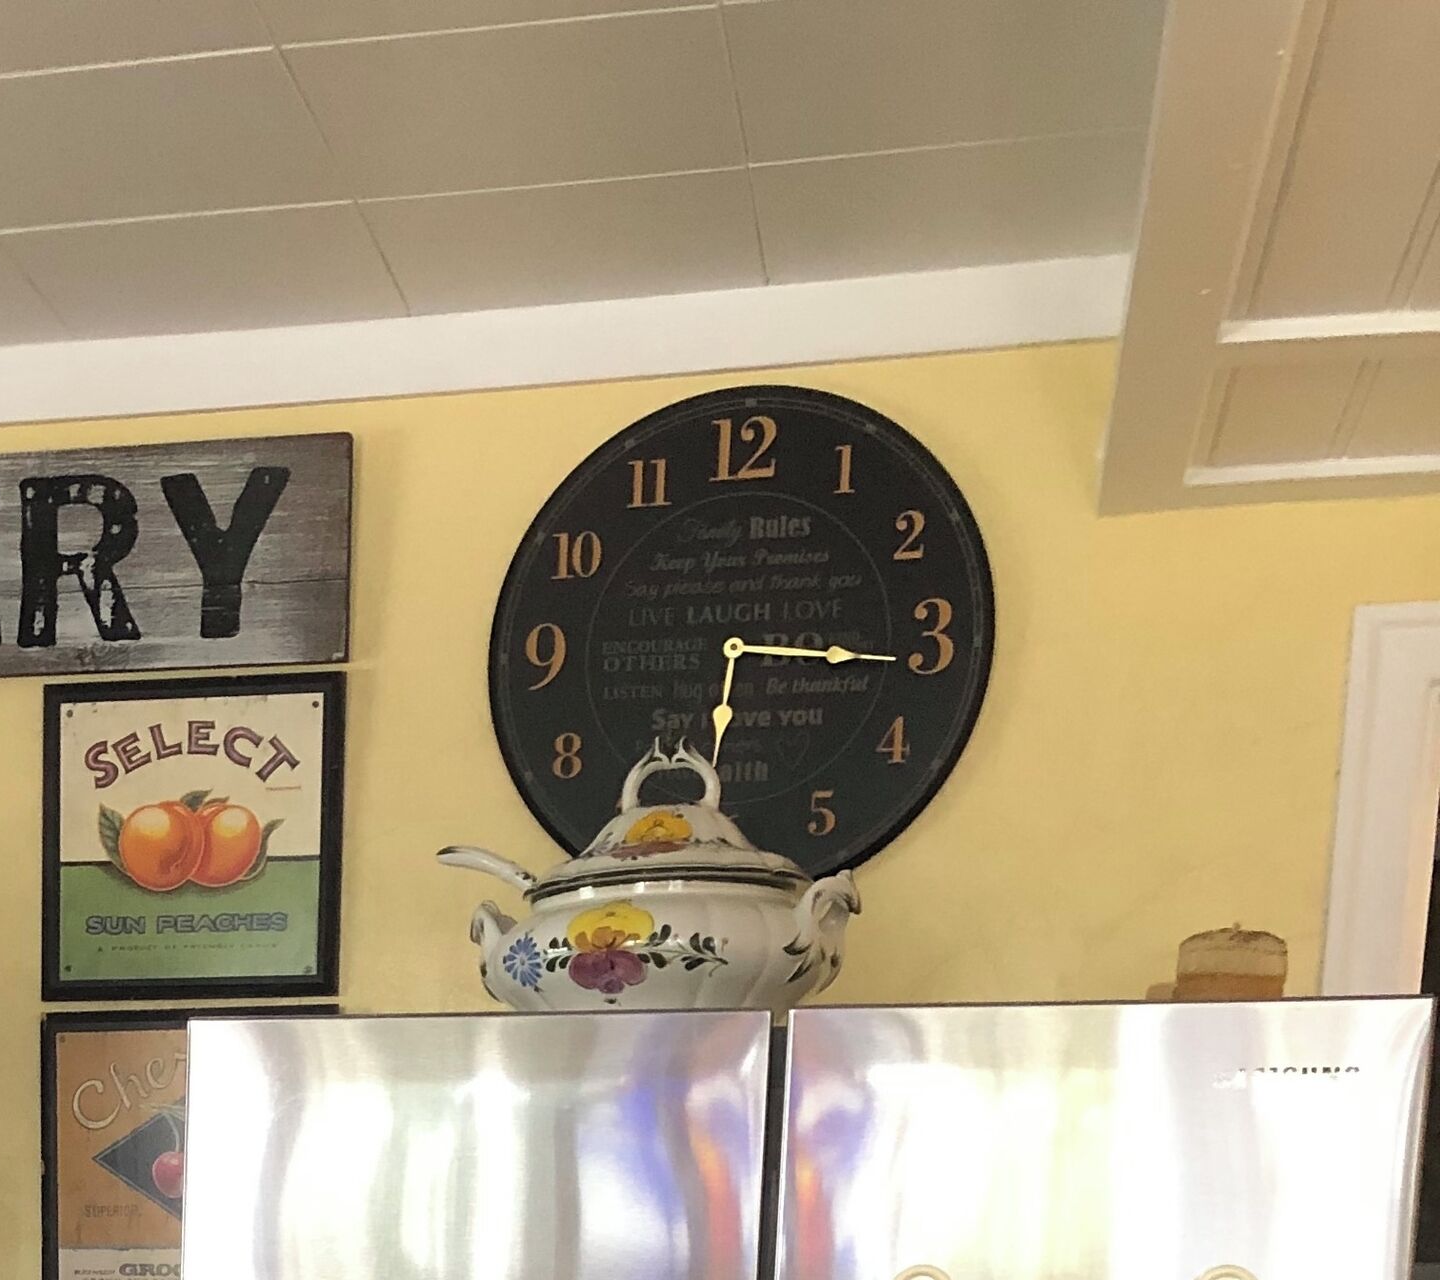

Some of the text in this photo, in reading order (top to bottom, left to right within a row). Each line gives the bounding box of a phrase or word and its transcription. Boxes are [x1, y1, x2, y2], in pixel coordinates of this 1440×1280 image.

[708, 415, 777, 482] 12
[833, 444, 856, 495] 1
[626, 458, 672, 509] 11
[750, 515, 812, 540] Rules
[893, 510, 925, 560] 2
[550, 530, 602, 580] 10
[628, 599, 843, 627] LIVE LAUGH LOVE
[908, 597, 954, 675] 3
[525, 623, 567, 691] 9
[602, 653, 701, 673] OTHERS
[651, 708, 692, 732] Say
[875, 716, 910, 764] 4
[84, 720, 300, 788] SELECT
[552, 733, 582, 779] 8
[807, 791, 836, 835] 5
[86, 912, 288, 935] SUN PEACHES
